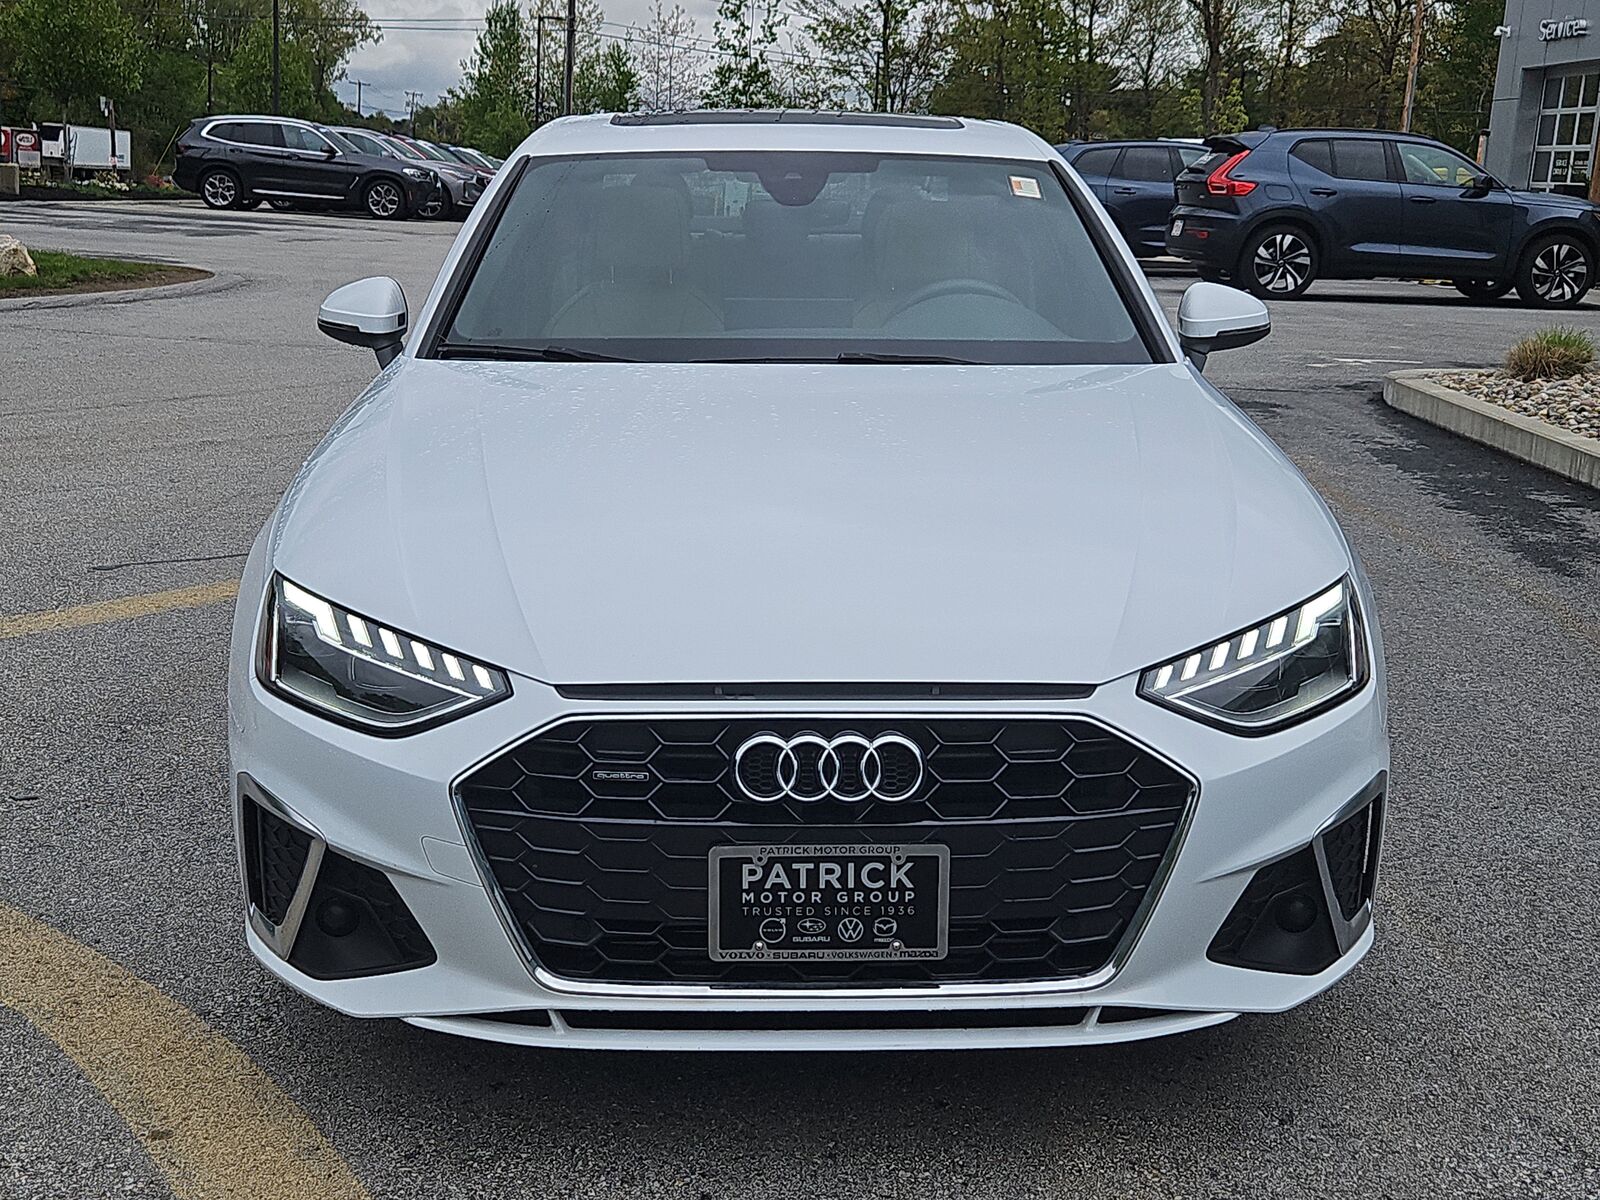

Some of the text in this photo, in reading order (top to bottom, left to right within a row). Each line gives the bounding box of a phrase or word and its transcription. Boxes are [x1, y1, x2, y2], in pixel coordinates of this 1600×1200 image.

[1538, 19, 1582, 41] Service
[760, 845, 901, 855] PATRICK MOTOR GROUP
[741, 862, 915, 890] PATRICK
[742, 891, 915, 904] MOTOR GROUP
[742, 905, 915, 916] TRUSTED SINCE 1936
[719, 950, 939, 960] VOLVO SUBARU VOLKSWAGEN mazda
